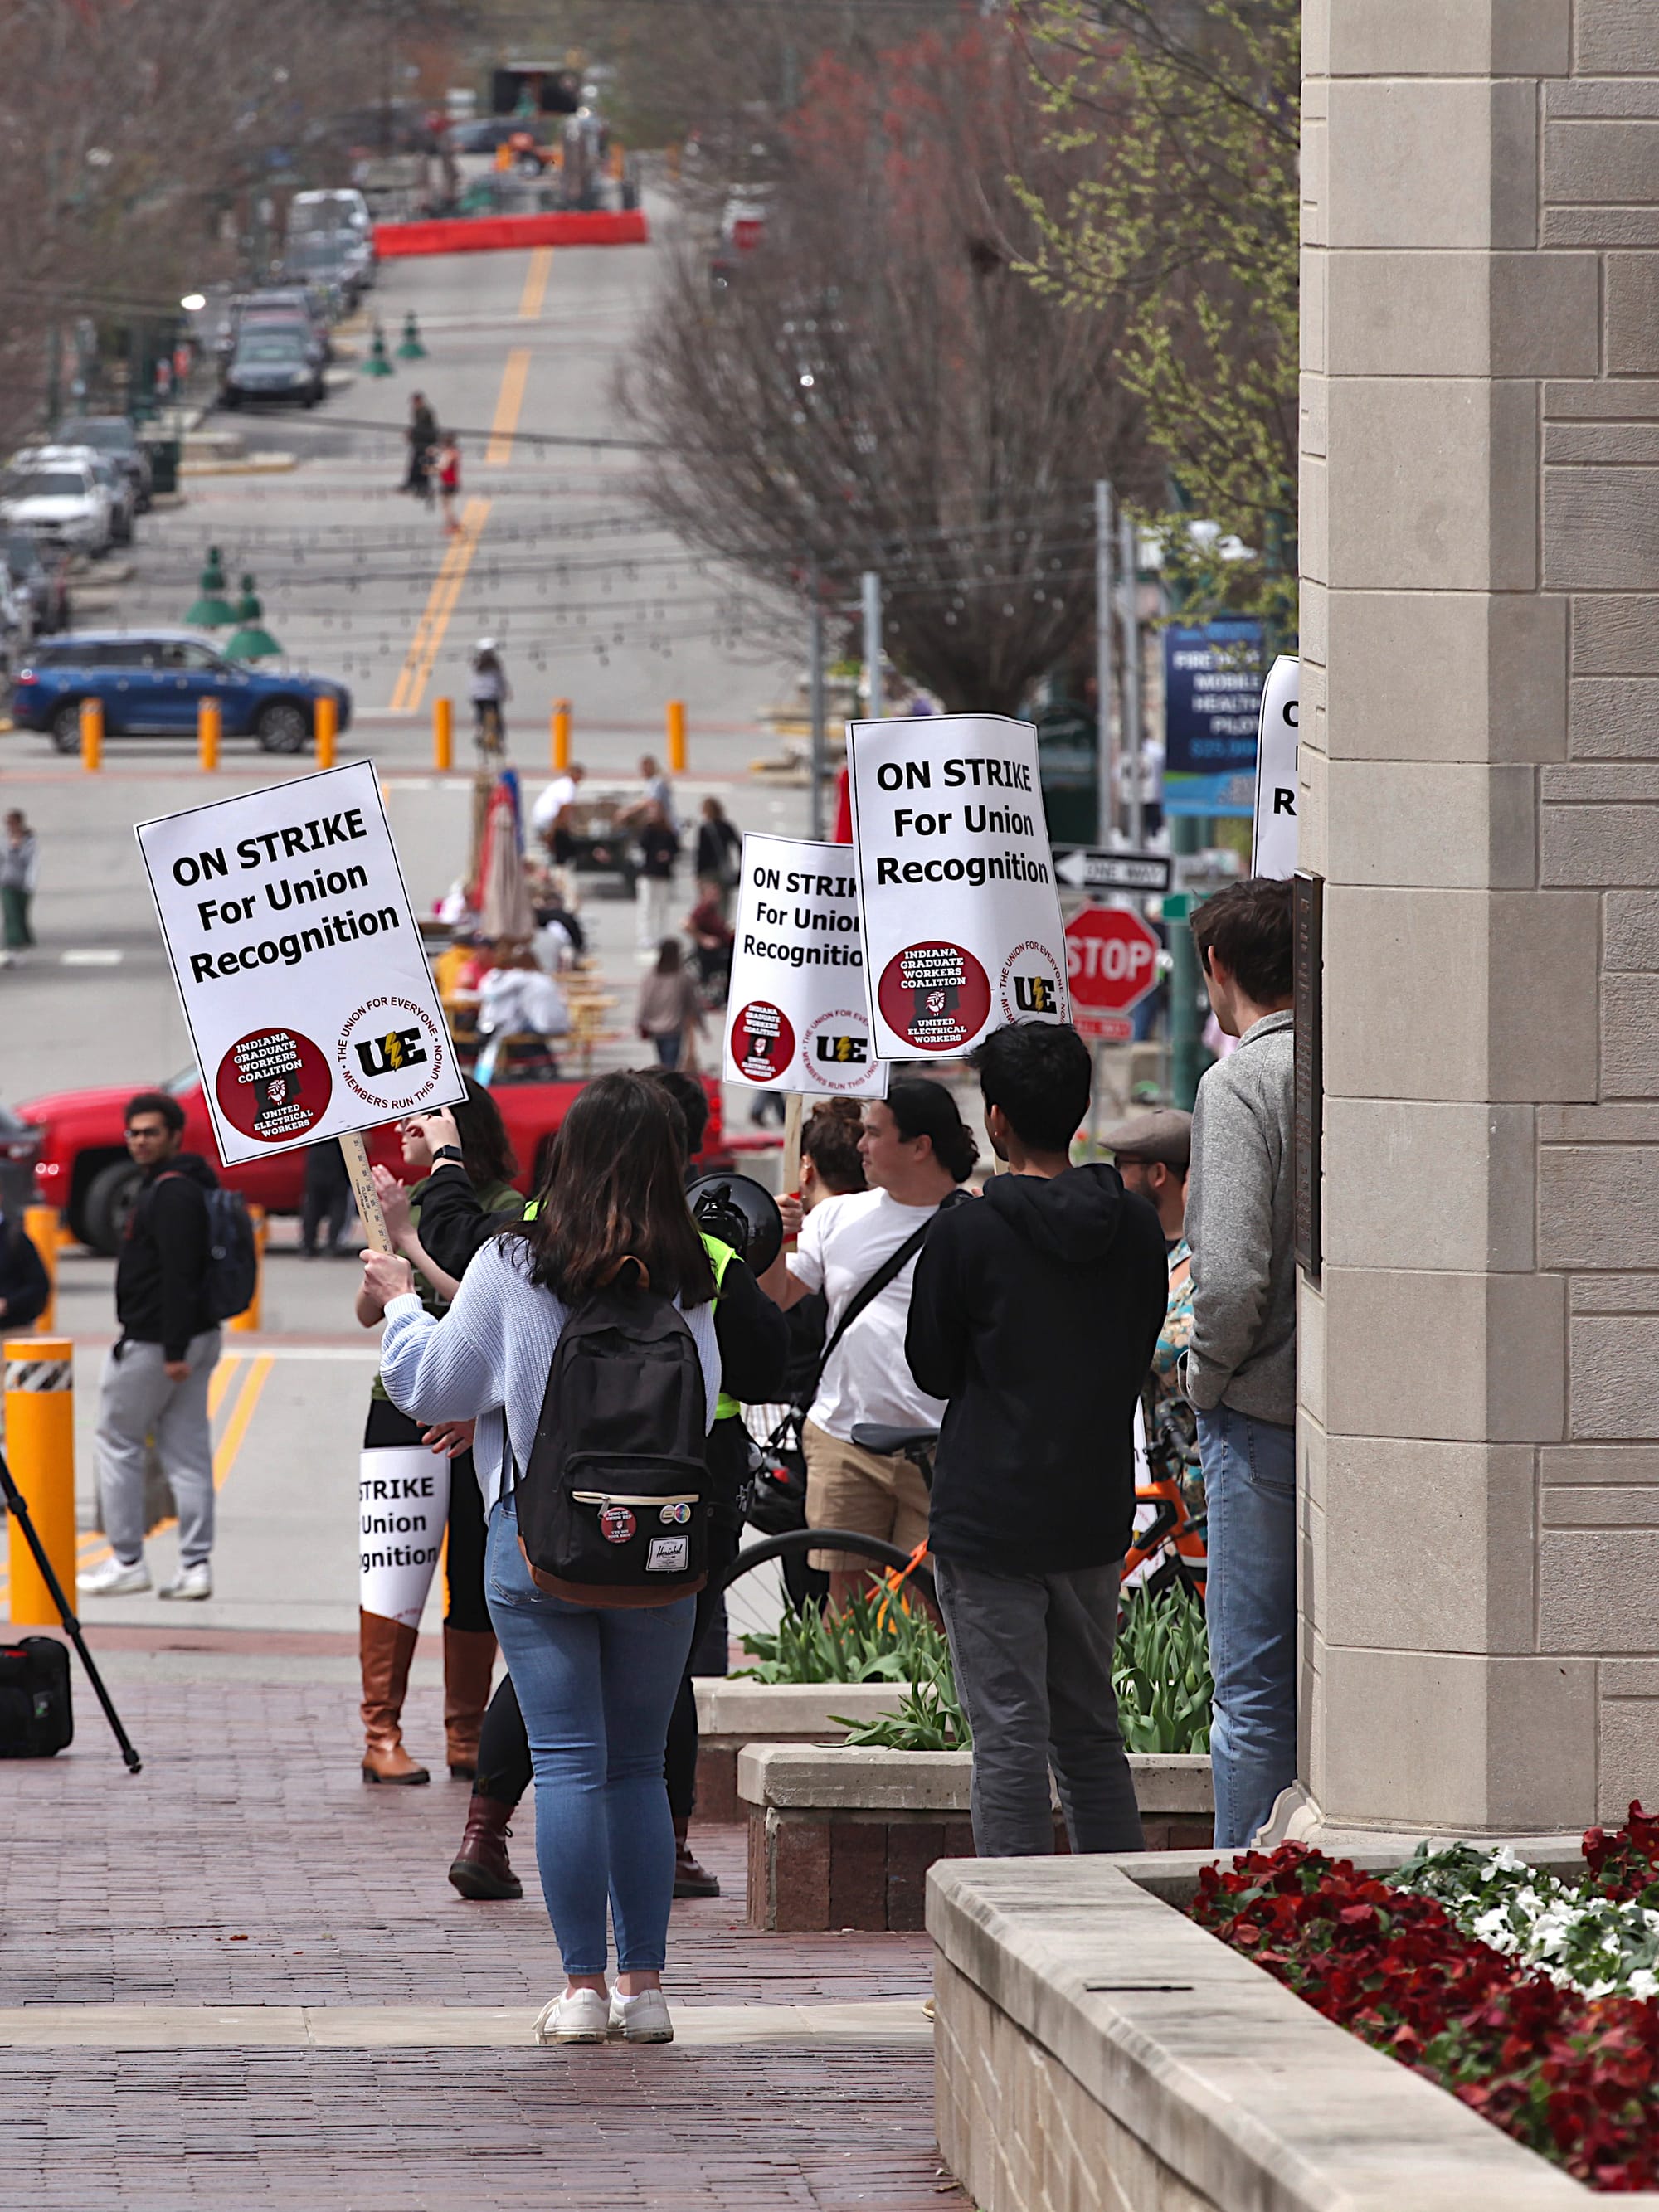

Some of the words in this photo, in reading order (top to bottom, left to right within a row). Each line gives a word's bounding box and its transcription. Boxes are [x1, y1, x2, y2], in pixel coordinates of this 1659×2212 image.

[877, 761, 930, 791] ON
[944, 759, 1032, 792] STRIKE
[895, 809, 952, 837] For
[964, 805, 1034, 836] Union
[173, 848, 229, 886] ON
[237, 808, 367, 869] STRIKE
[754, 867, 779, 890] ON
[877, 851, 1048, 887] Recognition
[198, 895, 256, 931] For
[265, 865, 368, 910] Union
[757, 902, 788, 925] For
[190, 906, 399, 983] Recognition
[905, 949, 958, 959] INDIANA
[900, 958, 963, 969] GRADUATE
[1000, 968, 1009, 988] THE
[1005, 943, 1025, 967] UNION
[1025, 941, 1039, 950] FOR
[1040, 945, 1064, 993] EVERYONE
[1067, 934, 1152, 981] STOP
[901, 977, 966, 988] COALITION
[904, 968, 962, 979] WORKERS
[367, 997, 388, 1010] FOR
[341, 1006, 366, 1037] UNION
[391, 997, 438, 1036] EVERYONE
[803, 1029, 813, 1043] THE
[810, 1011, 833, 1029] UNION
[918, 1018, 955, 1027] UNITED
[908, 1026, 967, 1036] ELECTRICAL
[914, 1035, 961, 1043] WORKERS
[234, 1040, 297, 1064] GRADUATE
[236, 1033, 289, 1053] INDIANA
[338, 1039, 347, 1062] THE
[238, 1060, 303, 1084] COALITION
[239, 1051, 297, 1073] WORKERS
[803, 1051, 827, 1085] MEMBERS
[828, 1081, 845, 1089] RUN
[848, 1077, 865, 1088] THIS
[343, 1071, 388, 1108] MEMBERS
[392, 1097, 414, 1108] RUN
[414, 1081, 434, 1101] THIS
[431, 1045, 443, 1080] UNION
[254, 1110, 313, 1130] ELECTRICAL
[262, 1104, 300, 1119] UNITED
[262, 1119, 310, 1137] WORKERS
[362, 1513, 426, 1534] Union
